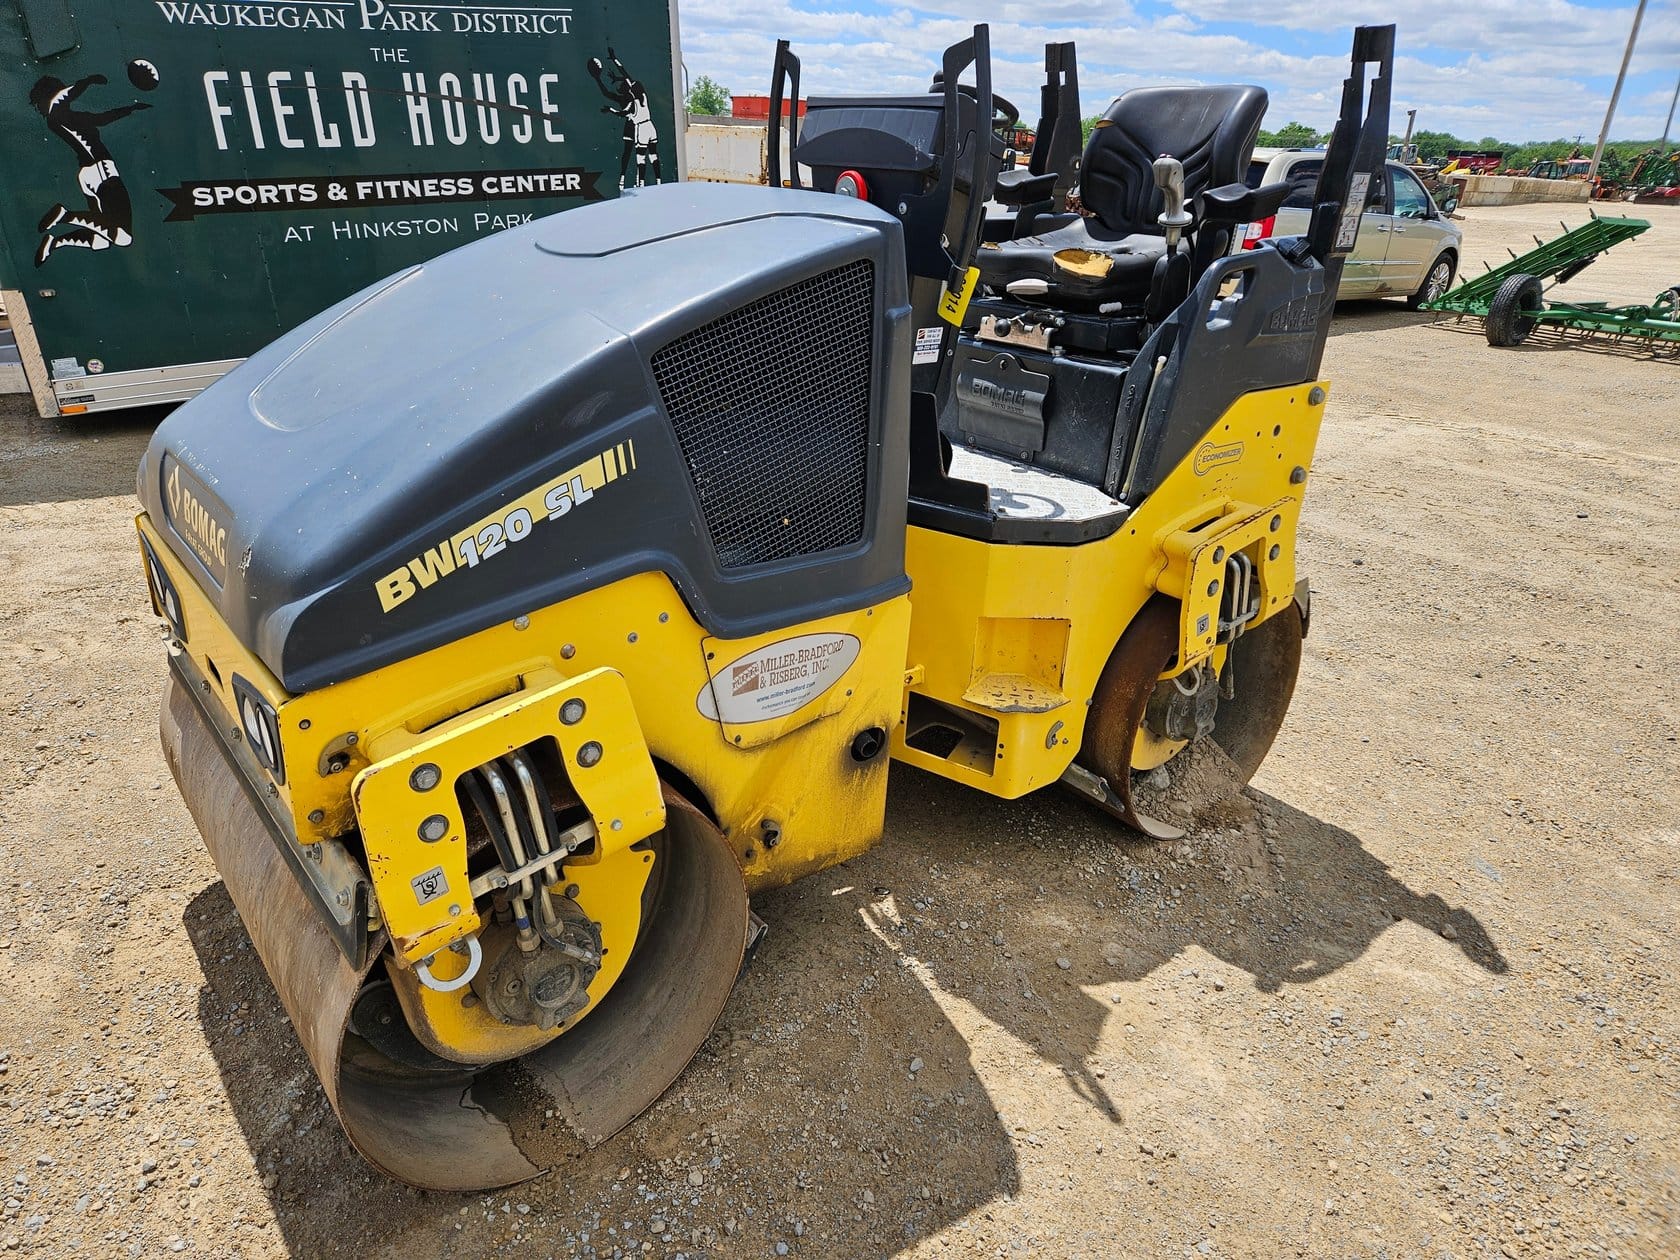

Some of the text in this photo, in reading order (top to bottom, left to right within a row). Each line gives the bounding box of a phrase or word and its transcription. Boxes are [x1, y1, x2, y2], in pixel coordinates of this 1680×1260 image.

[155, 0, 573, 34] WAUKEGAN PARK DISTRICT
[370, 47, 410, 63] THE
[203, 71, 565, 150] FIELD HOUSE
[192, 173, 582, 207] SPORTS & FITNESS CENTER
[284, 212, 533, 243] AT HINKSTON PARK
[972, 378, 1026, 406] BOMAG
[543, 474, 594, 521] SL
[183, 488, 226, 567] BOMAG
[759, 639, 844, 674] MILLER-BRADFORD
[759, 676, 767, 689] &
[769, 665, 810, 687] RISBERG,
